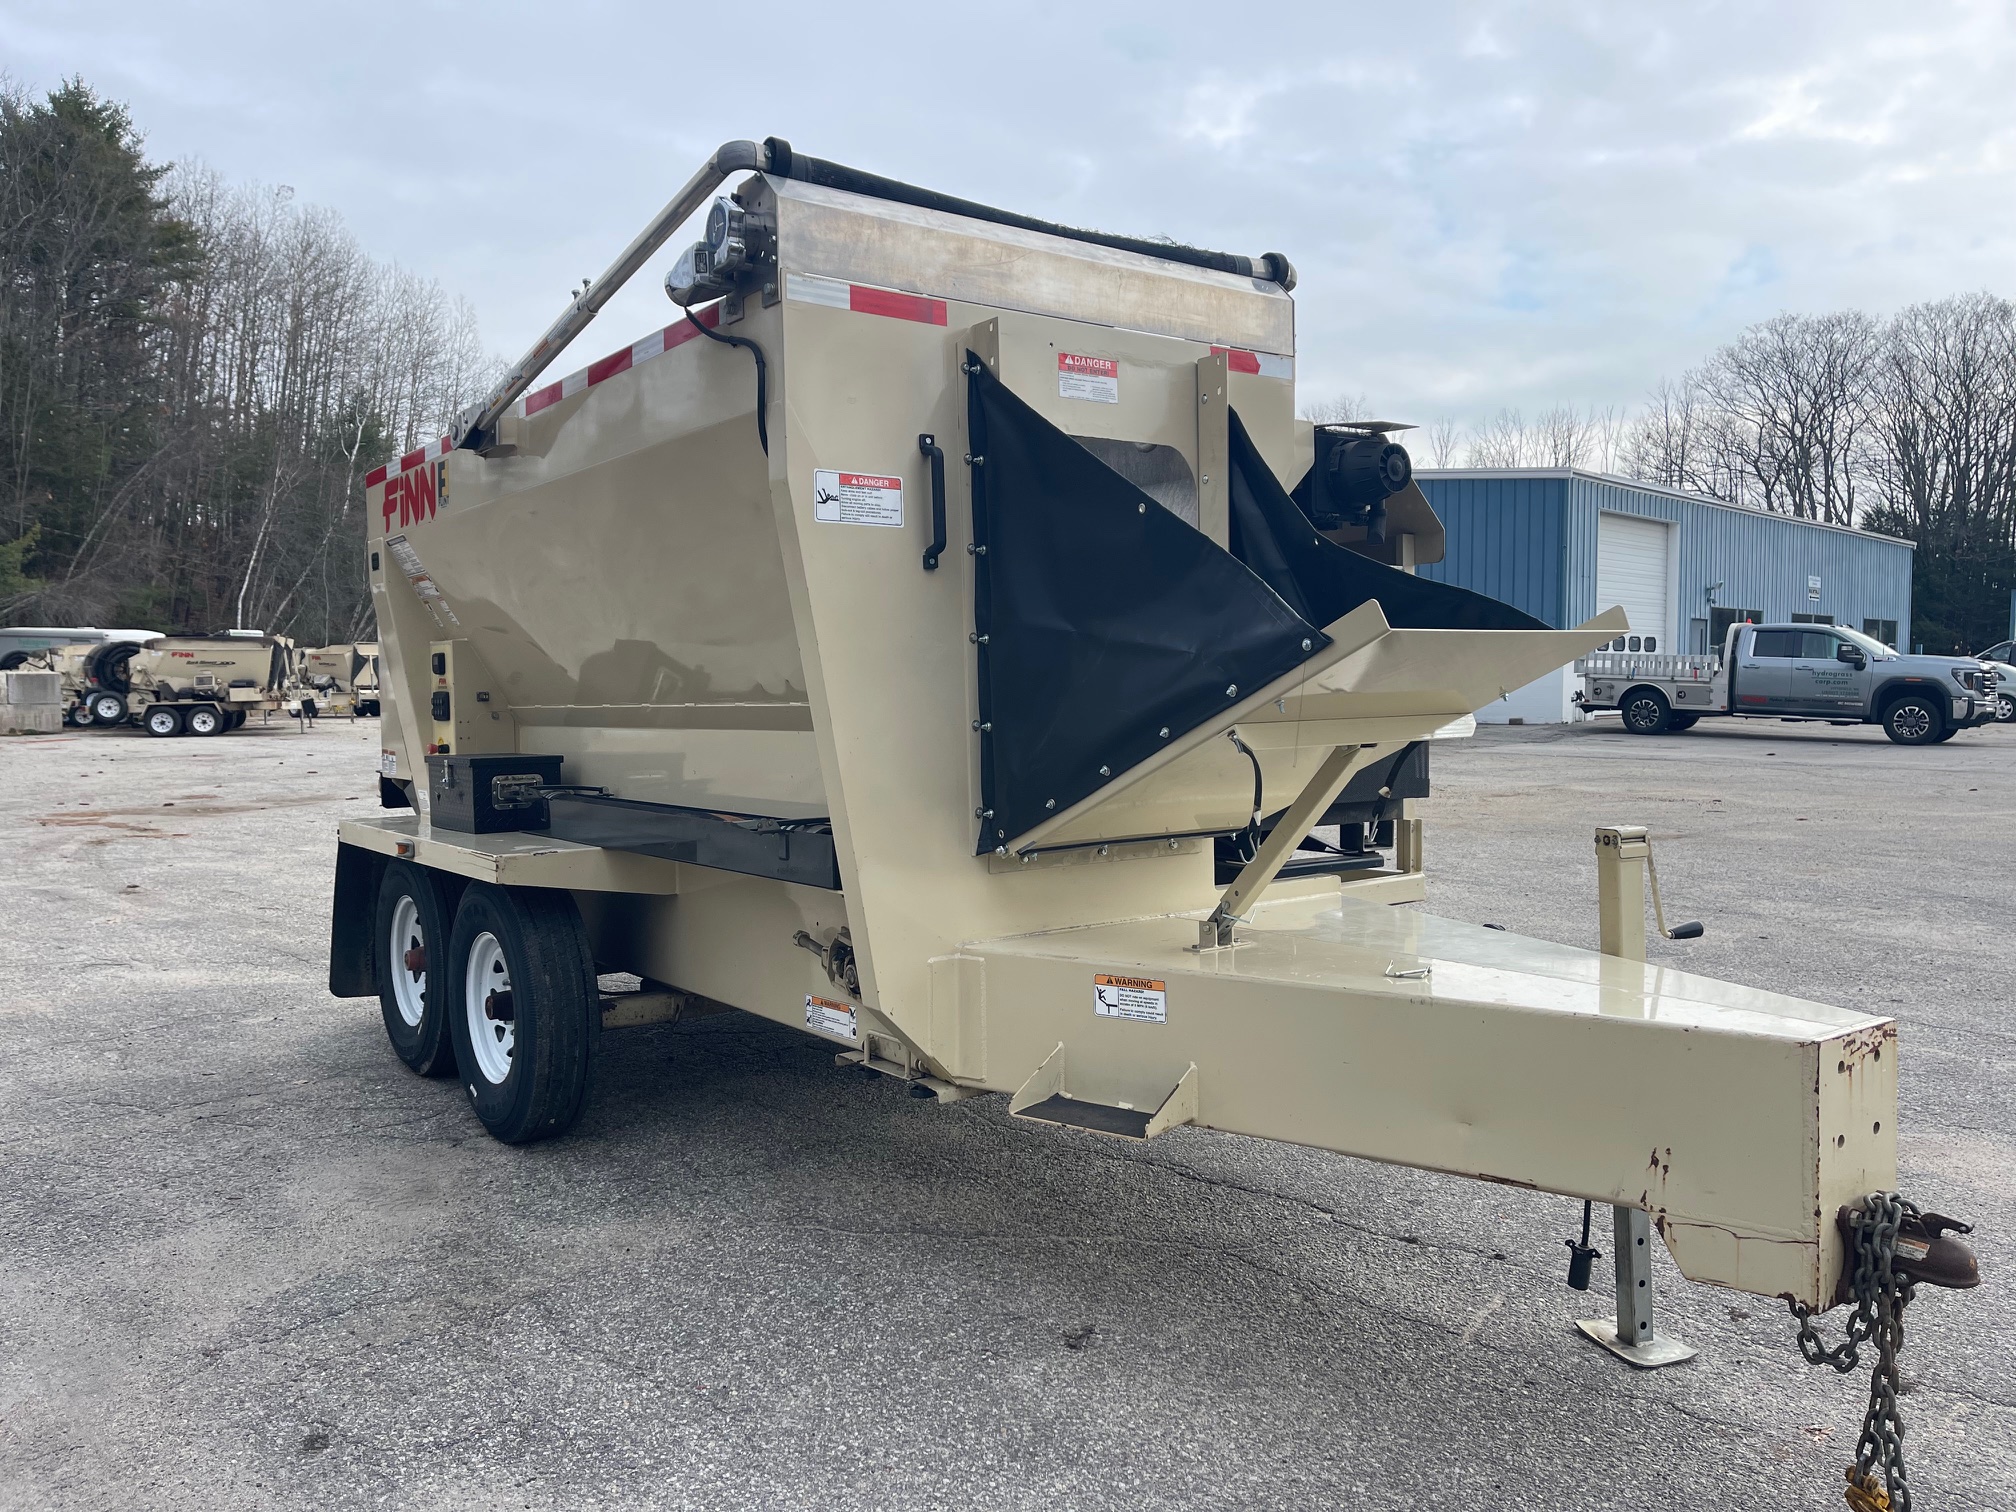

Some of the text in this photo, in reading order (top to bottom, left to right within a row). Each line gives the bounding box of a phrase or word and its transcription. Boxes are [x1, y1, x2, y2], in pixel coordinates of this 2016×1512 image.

[1075, 356, 1111, 369] DANGER
[858, 477, 889, 487] DANGER
[383, 461, 436, 533] FINN
[1812, 670, 1853, 678] hydrograss
[1115, 977, 1153, 988] WARNING
